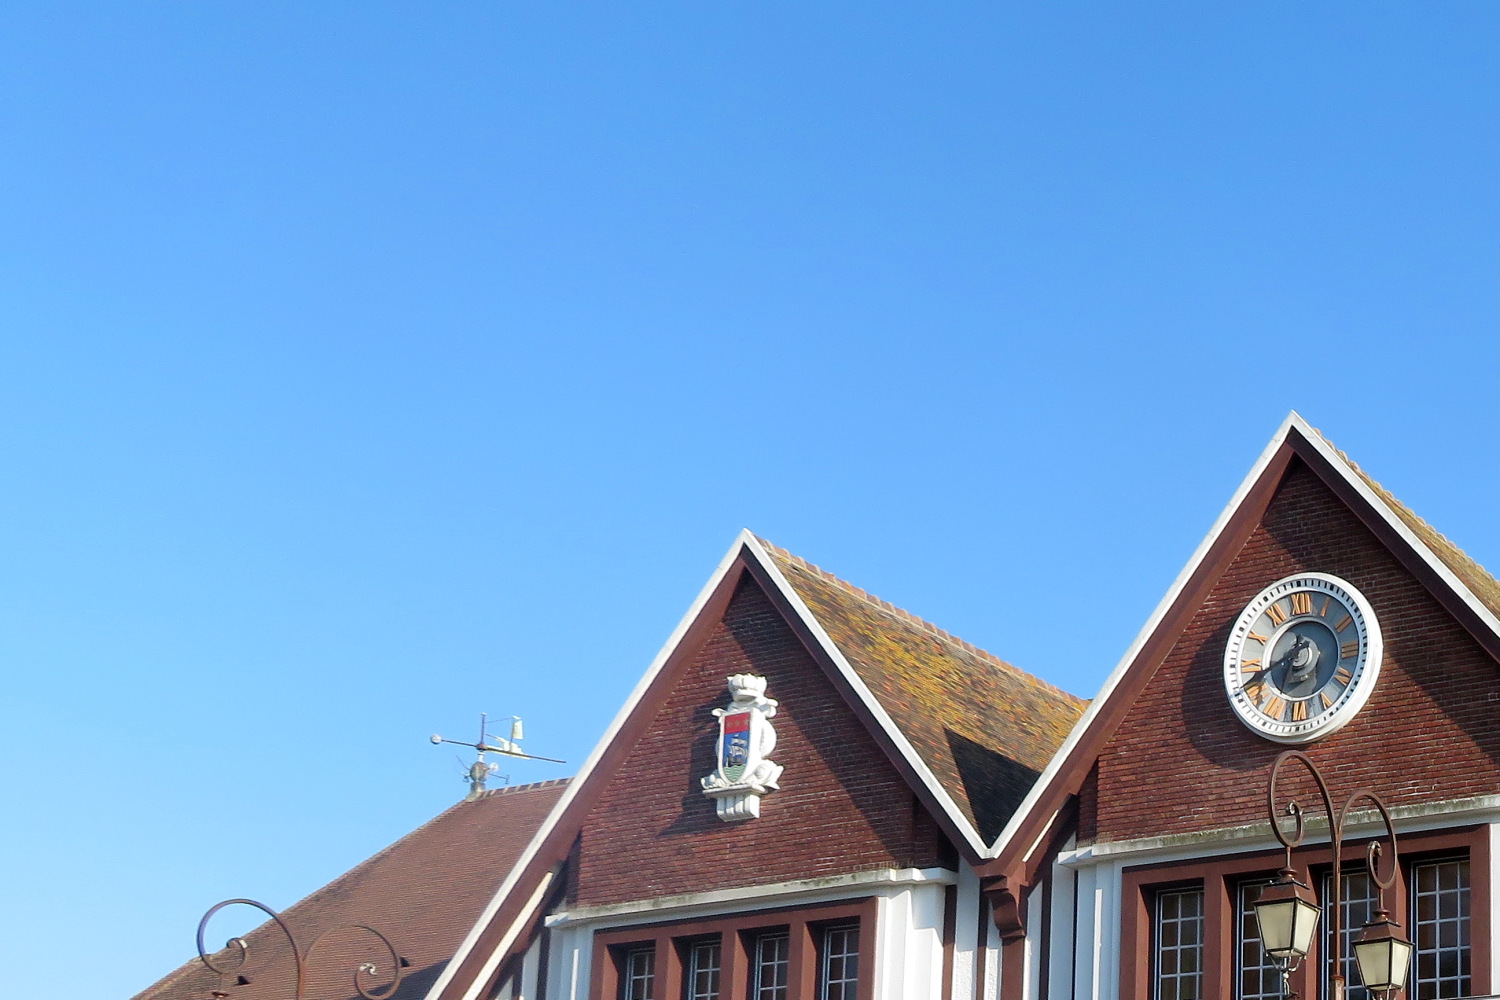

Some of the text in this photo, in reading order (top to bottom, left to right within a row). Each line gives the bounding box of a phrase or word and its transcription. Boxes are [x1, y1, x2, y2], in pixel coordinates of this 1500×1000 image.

[1290, 592, 1311, 616] XII
[1265, 602, 1287, 628] XI
[1334, 614, 1353, 633] II
[1247, 629, 1268, 645] X
[1341, 641, 1358, 659] III
[1241, 657, 1261, 673] IX
[1335, 667, 1352, 686] IV
[1264, 696, 1286, 720] VII
[1320, 691, 1333, 710] V
[1292, 701, 1307, 722] VI
